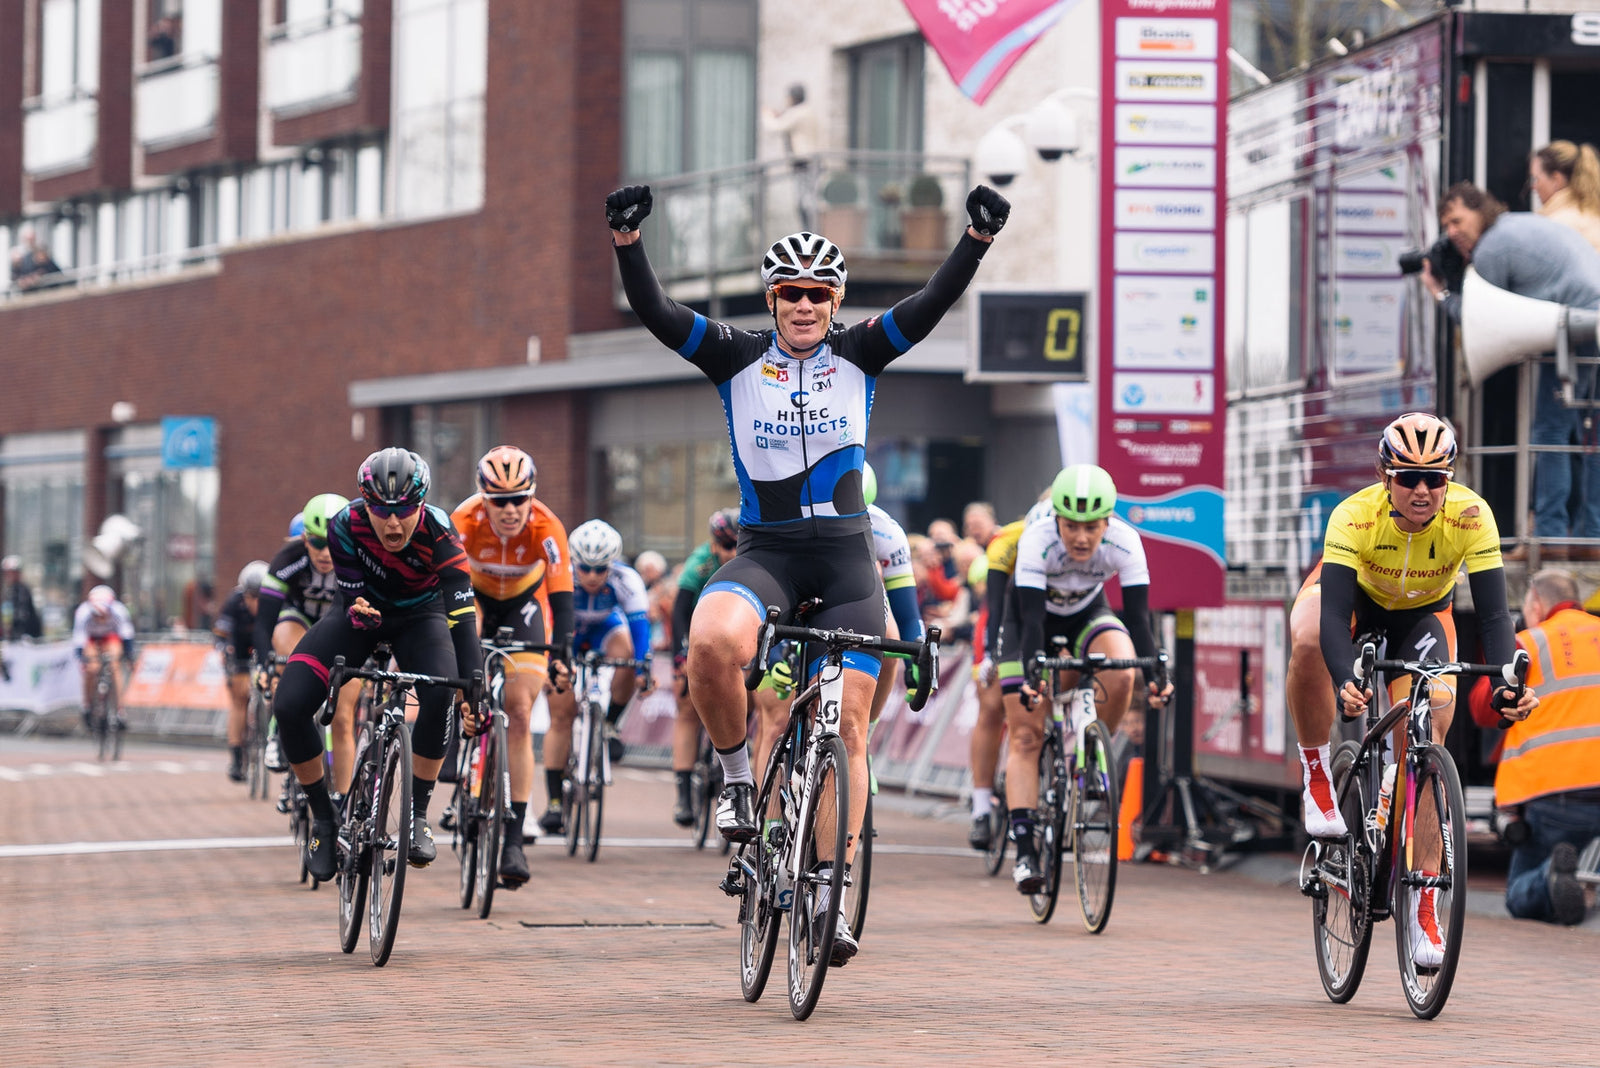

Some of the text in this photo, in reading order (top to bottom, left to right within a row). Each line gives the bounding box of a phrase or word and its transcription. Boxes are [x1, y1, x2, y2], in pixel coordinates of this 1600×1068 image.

[1043, 308, 1081, 361] 0
[777, 408, 829, 422] HITEC
[754, 417, 847, 436] PRODUCTS
